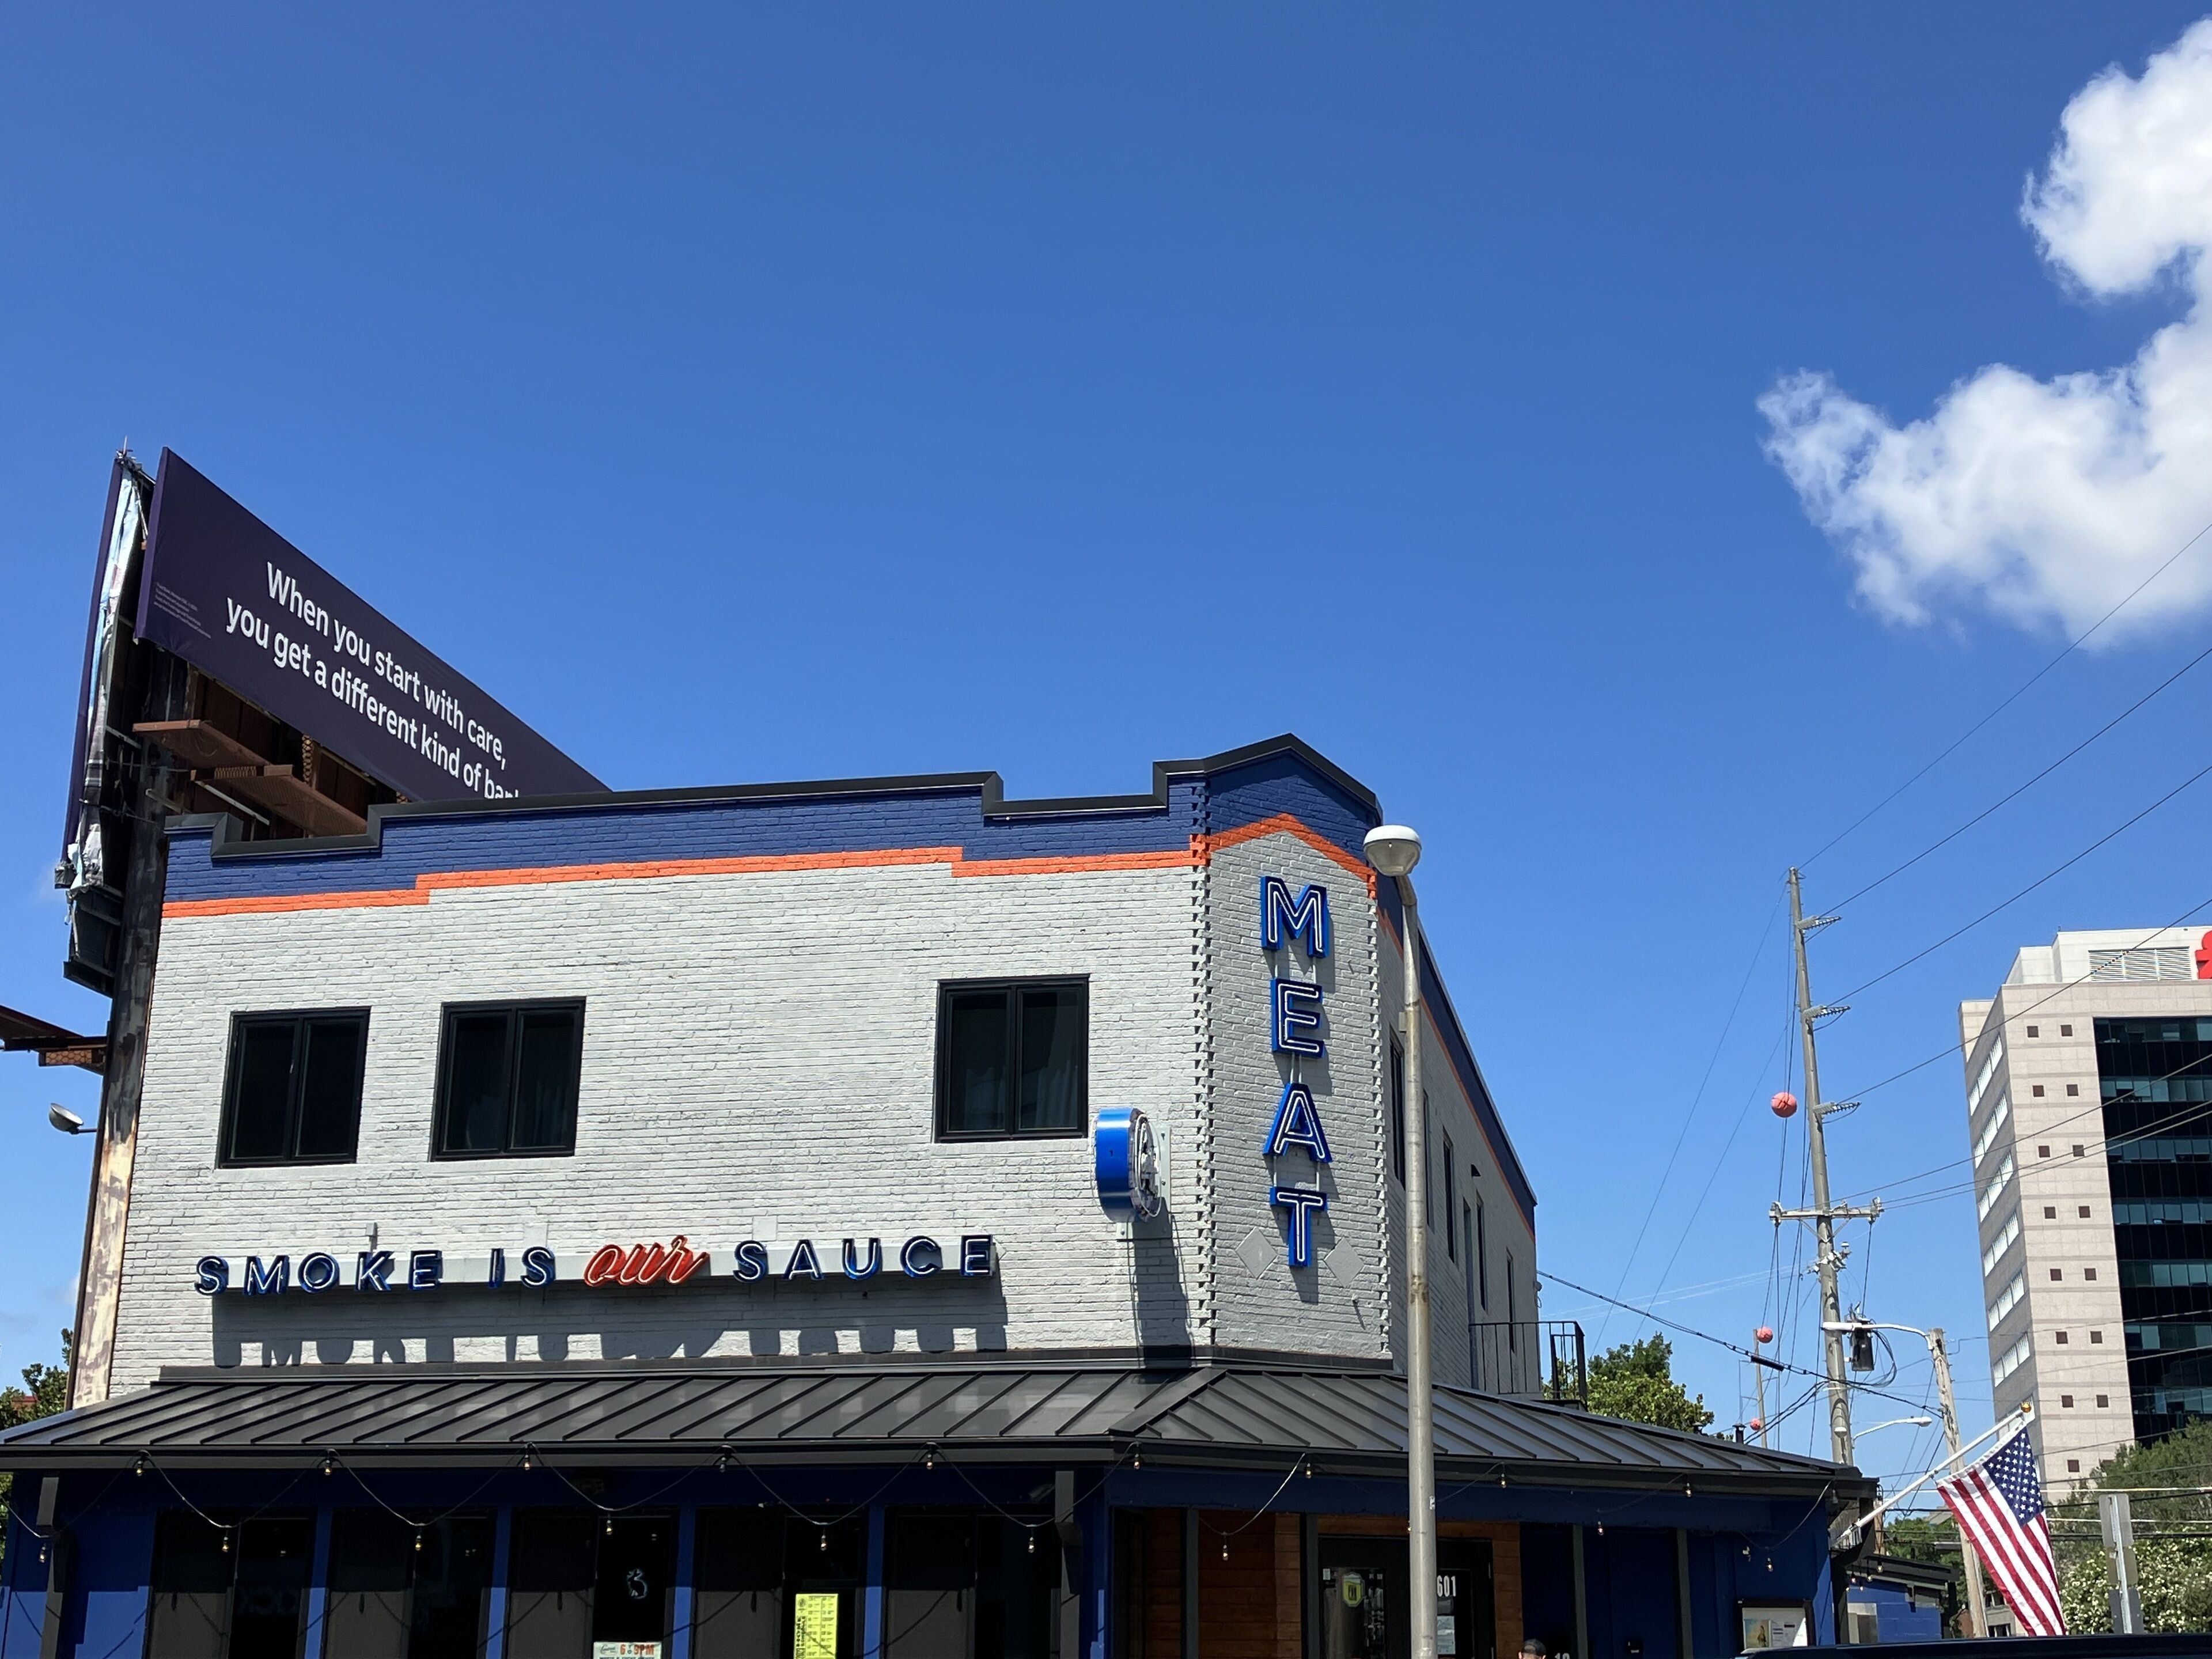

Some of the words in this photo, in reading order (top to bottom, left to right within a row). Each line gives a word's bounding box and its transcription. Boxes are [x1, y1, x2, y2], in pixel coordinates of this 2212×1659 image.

[226, 597, 270, 649] you
[273, 632, 311, 677] get
[315, 660, 327, 689] a
[331, 666, 418, 749] different
[421, 723, 460, 778] kind
[463, 763, 482, 792] of
[484, 768, 519, 799] ba
[267, 562, 328, 637] When
[334, 619, 370, 666] you
[374, 651, 421, 702] start
[424, 685, 464, 734] with
[467, 719, 506, 770] care,
[1260, 876, 1332, 1267] MEAT
[195, 1250, 443, 1296] SMOKE
[487, 1246, 556, 1290] IS
[583, 1235, 710, 1287] our
[733, 1235, 995, 1282] SAUCE
